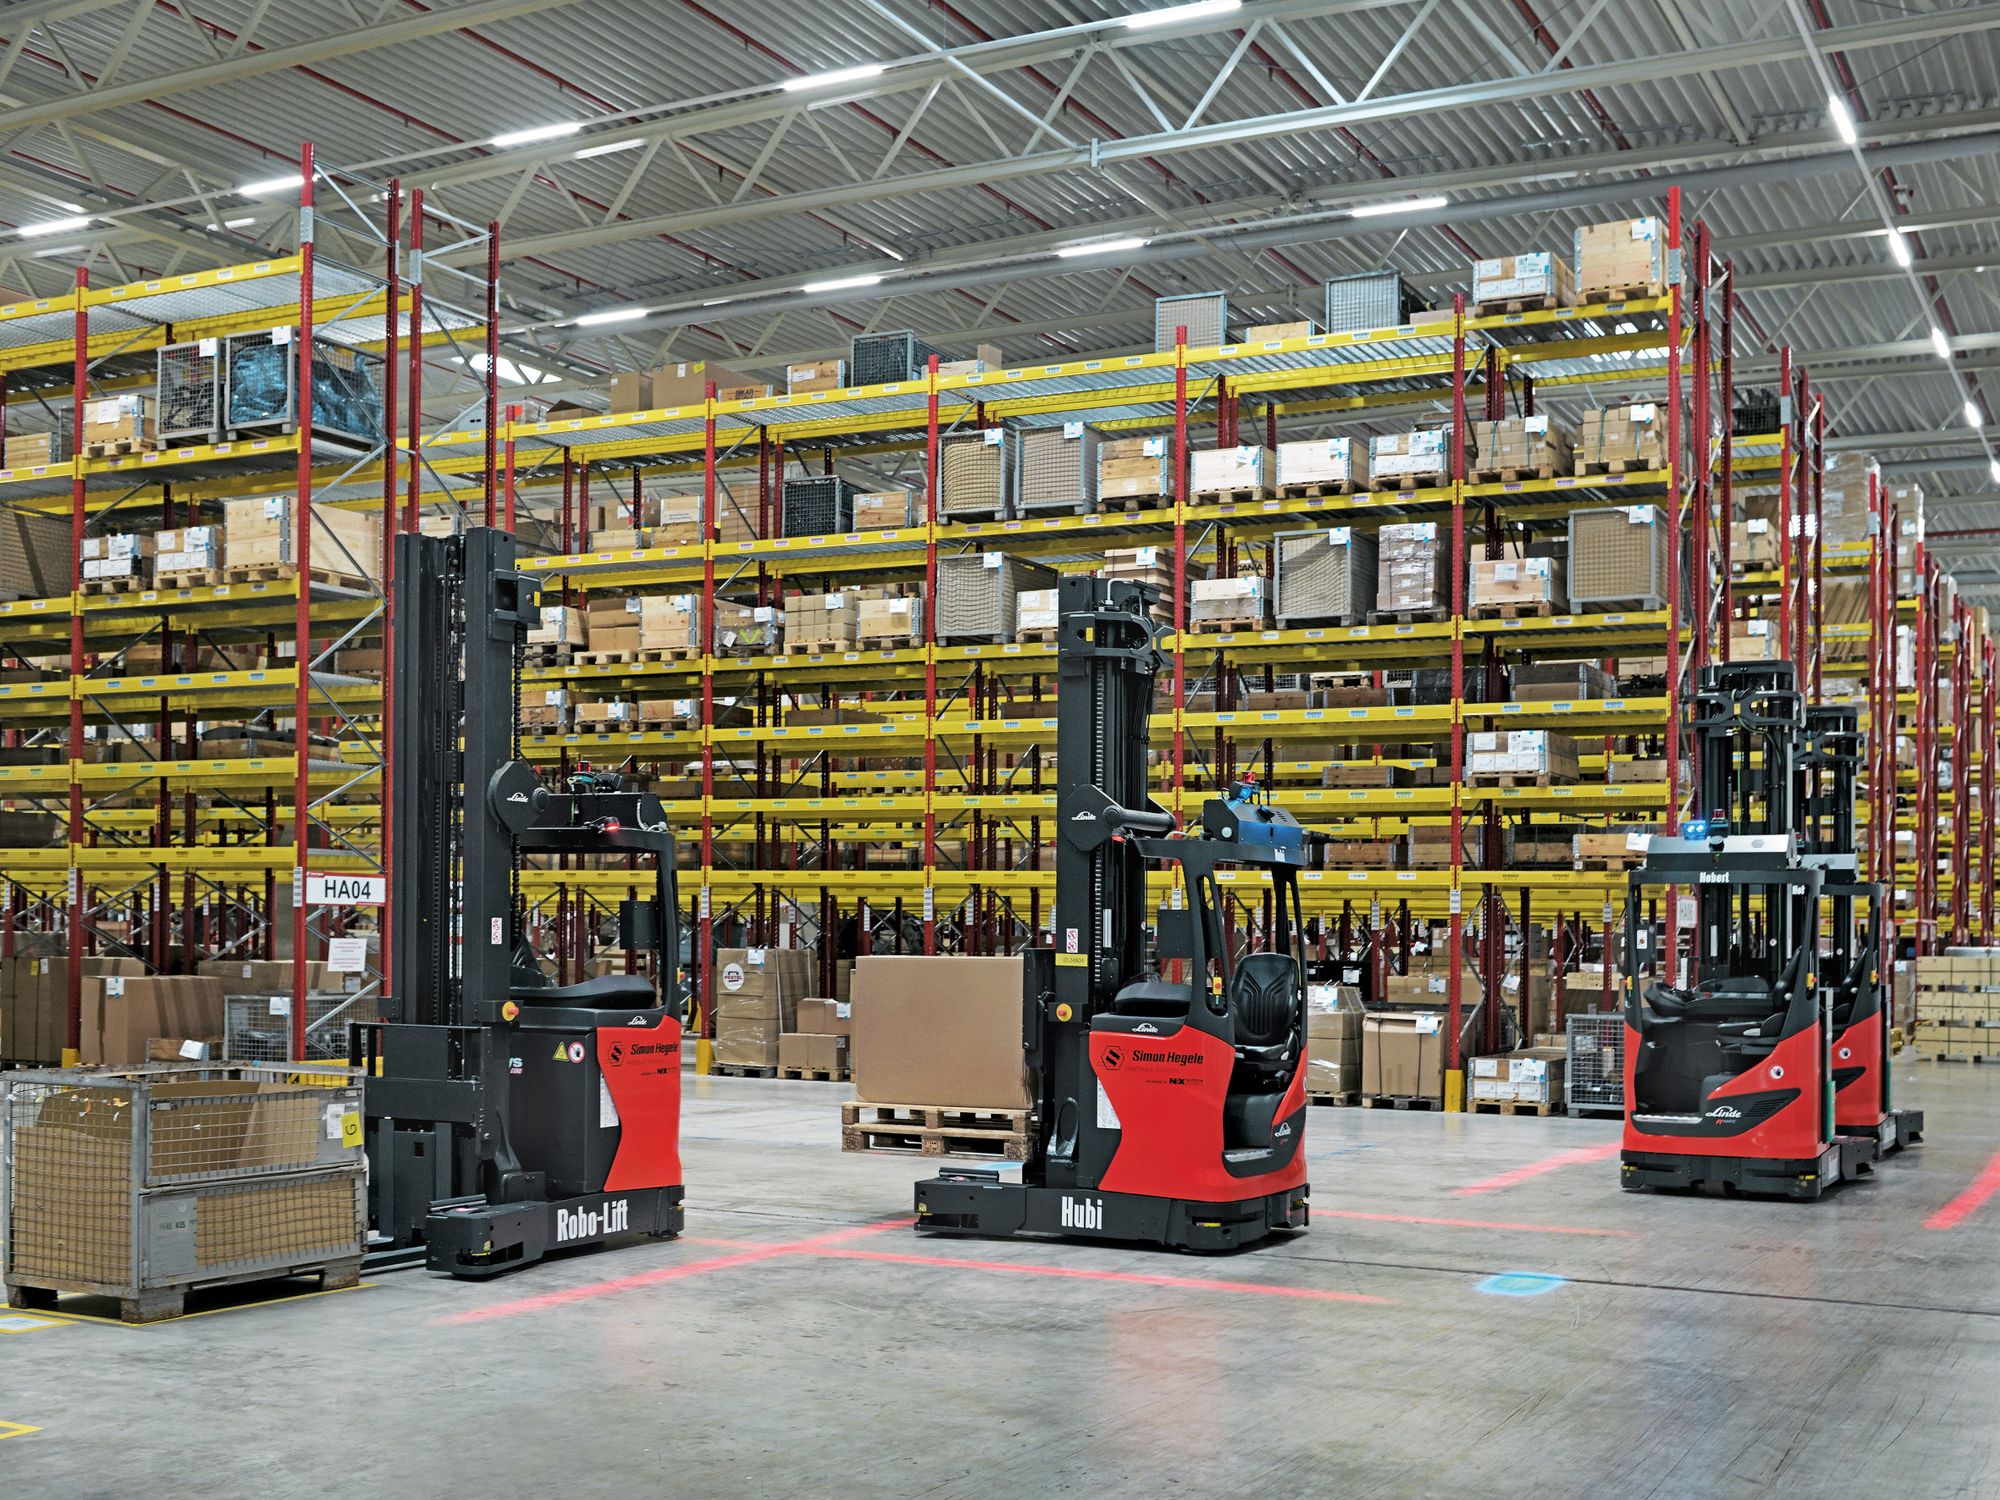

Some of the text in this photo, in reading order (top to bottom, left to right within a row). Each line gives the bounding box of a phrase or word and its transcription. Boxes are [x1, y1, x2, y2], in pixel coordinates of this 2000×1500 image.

[324, 879, 371, 899] HA04
[627, 1015, 648, 1026] Linde
[1131, 1022, 1158, 1033] Linde
[630, 1042, 679, 1056] Simon Hegele
[1132, 1049, 1204, 1066] Simon Hegele
[1169, 1077, 1185, 1085] NX
[1704, 1105, 1742, 1118] Linde
[1061, 1196, 1103, 1230] Hubi
[557, 1199, 628, 1242] Robo-Lift
